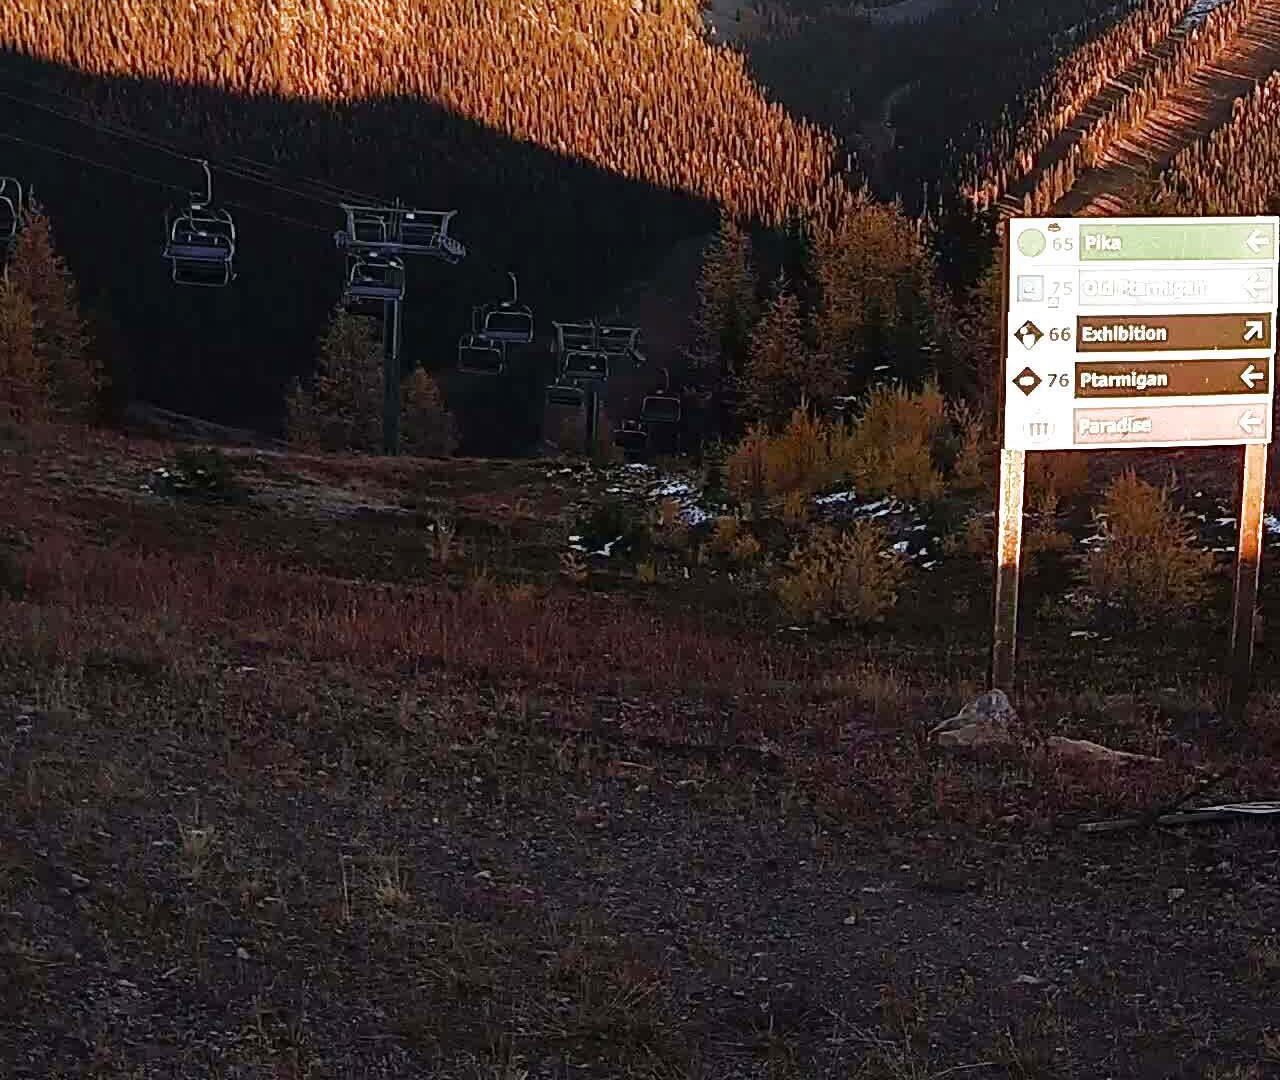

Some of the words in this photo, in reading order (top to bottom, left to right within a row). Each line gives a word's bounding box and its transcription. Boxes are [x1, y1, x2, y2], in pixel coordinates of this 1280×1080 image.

[1052, 237, 1073, 251] 65
[1084, 234, 1121, 251] Pika
[1050, 281, 1073, 296] 75
[1049, 327, 1071, 342] 66
[1081, 326, 1167, 342] Exhibition
[1047, 373, 1070, 388] 76
[1080, 372, 1168, 390] Ptarmigan
[1079, 416, 1152, 435] Paradise
